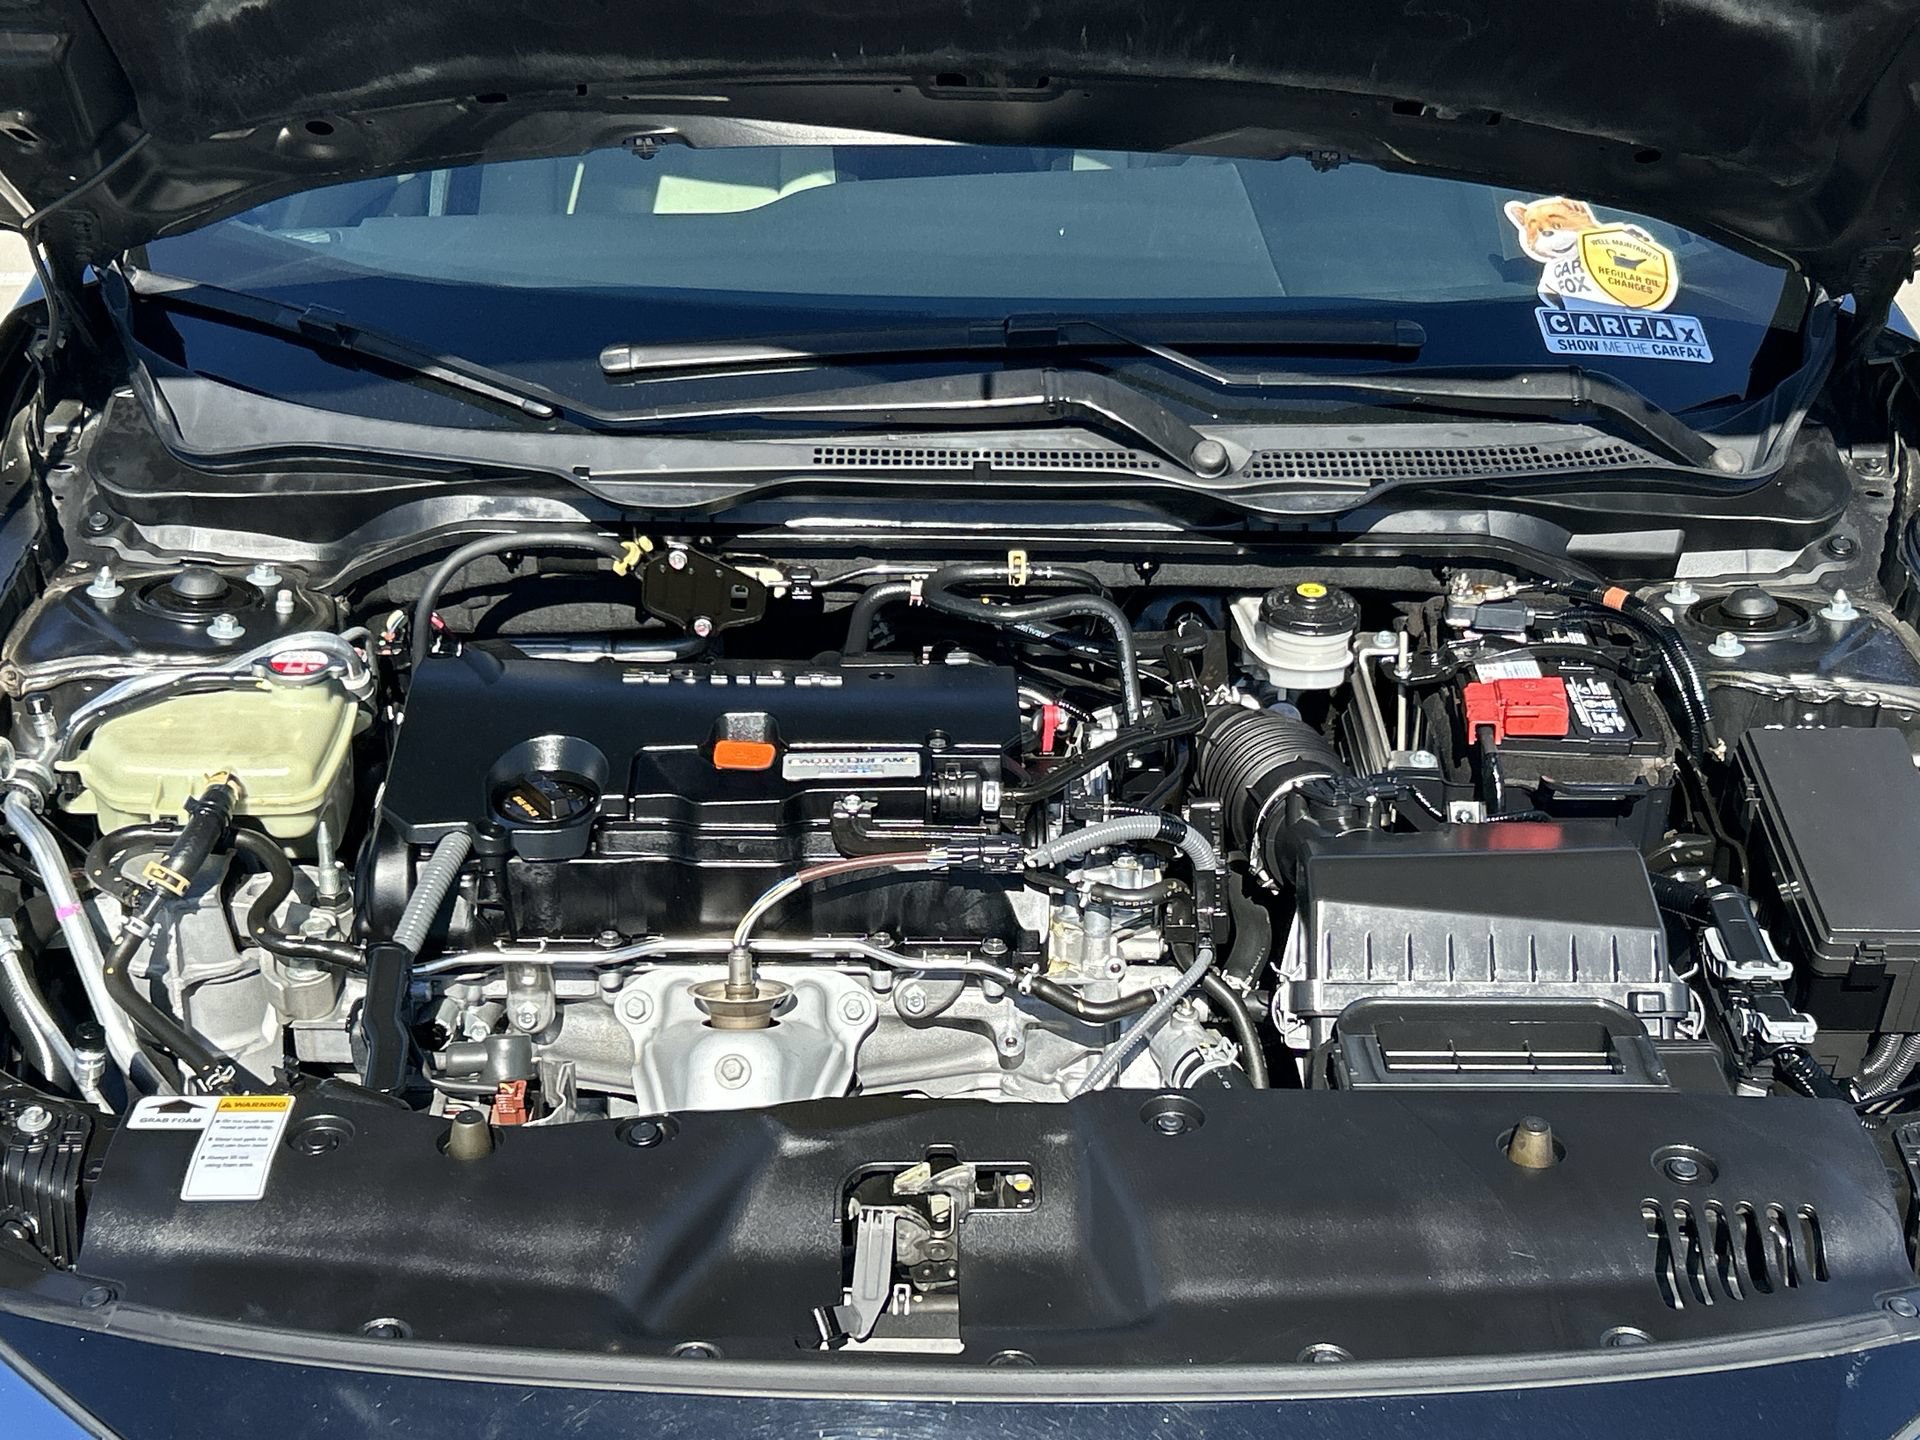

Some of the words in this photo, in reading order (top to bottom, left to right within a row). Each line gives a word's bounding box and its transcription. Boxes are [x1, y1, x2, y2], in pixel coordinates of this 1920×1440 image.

[1554, 259, 1584, 278] CAR
[1598, 266, 1642, 283] REGULAR
[1645, 277, 1661, 288] OIL
[1558, 276, 1592, 293] FOX
[1608, 277, 1653, 294] CHANGES
[1548, 314, 1699, 344] CARFAX
[1557, 339, 1599, 352] SHOW
[1602, 340, 1622, 353] ME
[1624, 341, 1649, 355] THE
[1652, 344, 1705, 360] CARFAX
